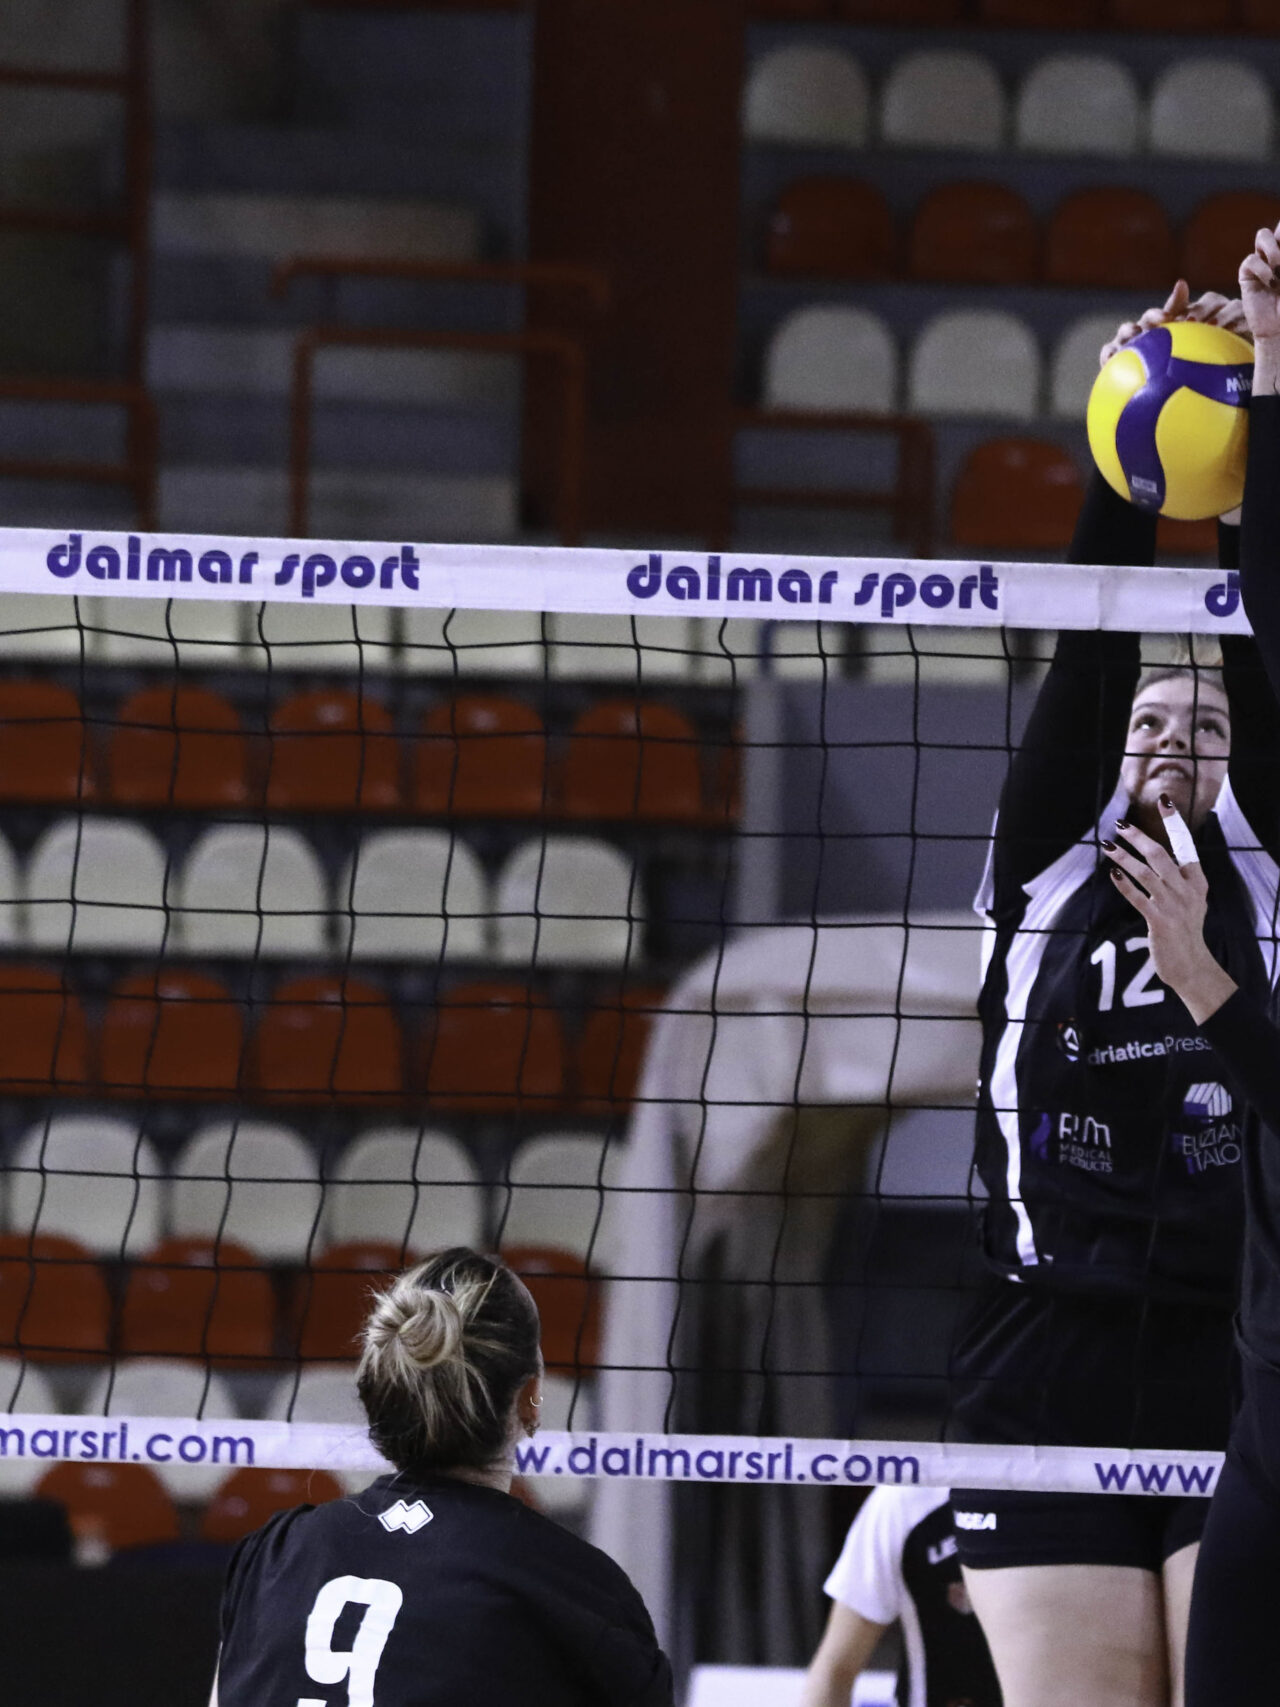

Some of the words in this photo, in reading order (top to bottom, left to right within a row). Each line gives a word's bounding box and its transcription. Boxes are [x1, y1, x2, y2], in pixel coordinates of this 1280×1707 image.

[47, 534, 258, 584] dalmar
[275, 546, 420, 597] sport
[627, 555, 839, 604] dalmar
[854, 565, 999, 618] sport
[1090, 937, 1165, 1011] 12
[0, 1422, 254, 1465] marsrl.com
[515, 1438, 920, 1485] w.dalmarsrl.com
[1094, 1463, 1216, 1494] www
[298, 1575, 403, 1707] 9
